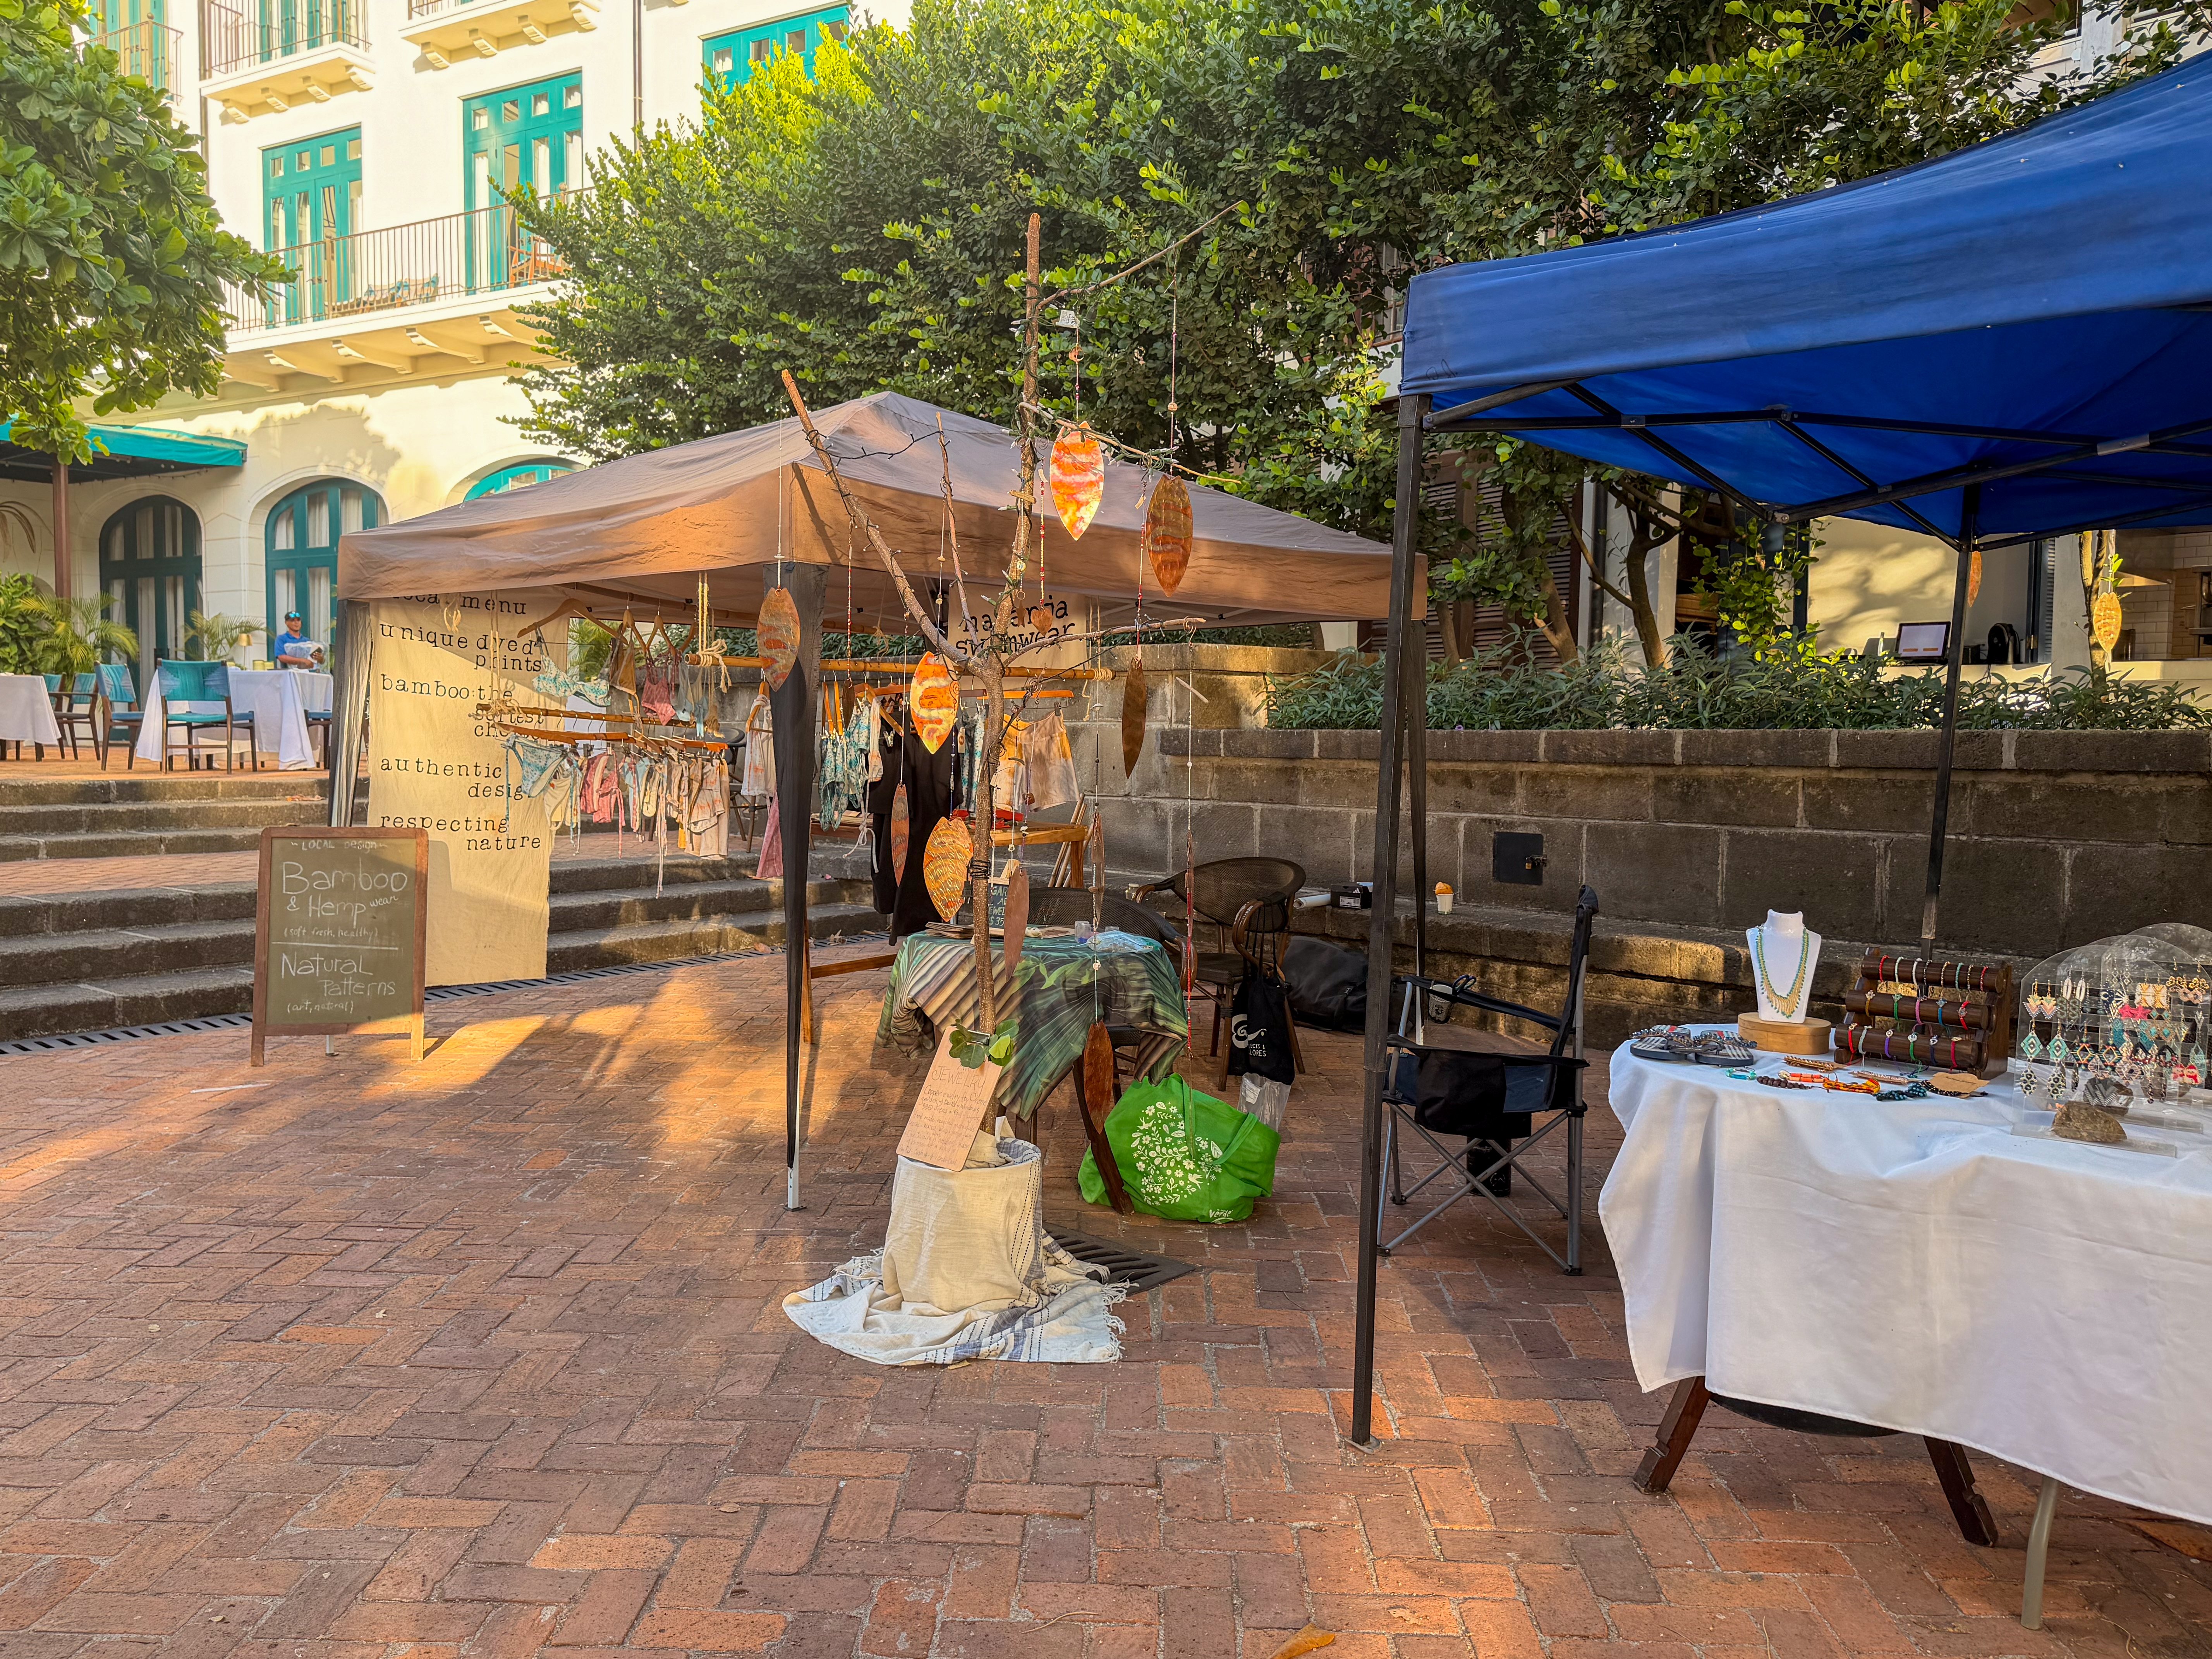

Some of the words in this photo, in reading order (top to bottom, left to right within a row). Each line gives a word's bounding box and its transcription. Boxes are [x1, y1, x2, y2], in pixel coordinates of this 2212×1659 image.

[460, 595, 526, 615] menu
[380, 623, 468, 647] unique
[476, 634, 534, 655] dyed
[474, 655, 541, 672] prints
[381, 758, 502, 778] authentic
[468, 783, 531, 800] desig
[380, 815, 508, 833] respecting
[301, 839, 335, 851] LOCAL
[466, 836, 541, 851] nature
[282, 856, 407, 895] Bamboo
[309, 893, 366, 929] Hemp
[370, 895, 399, 907] wear
[318, 977, 395, 996] Patterns
[931, 1065, 986, 1100] JEWELRY
